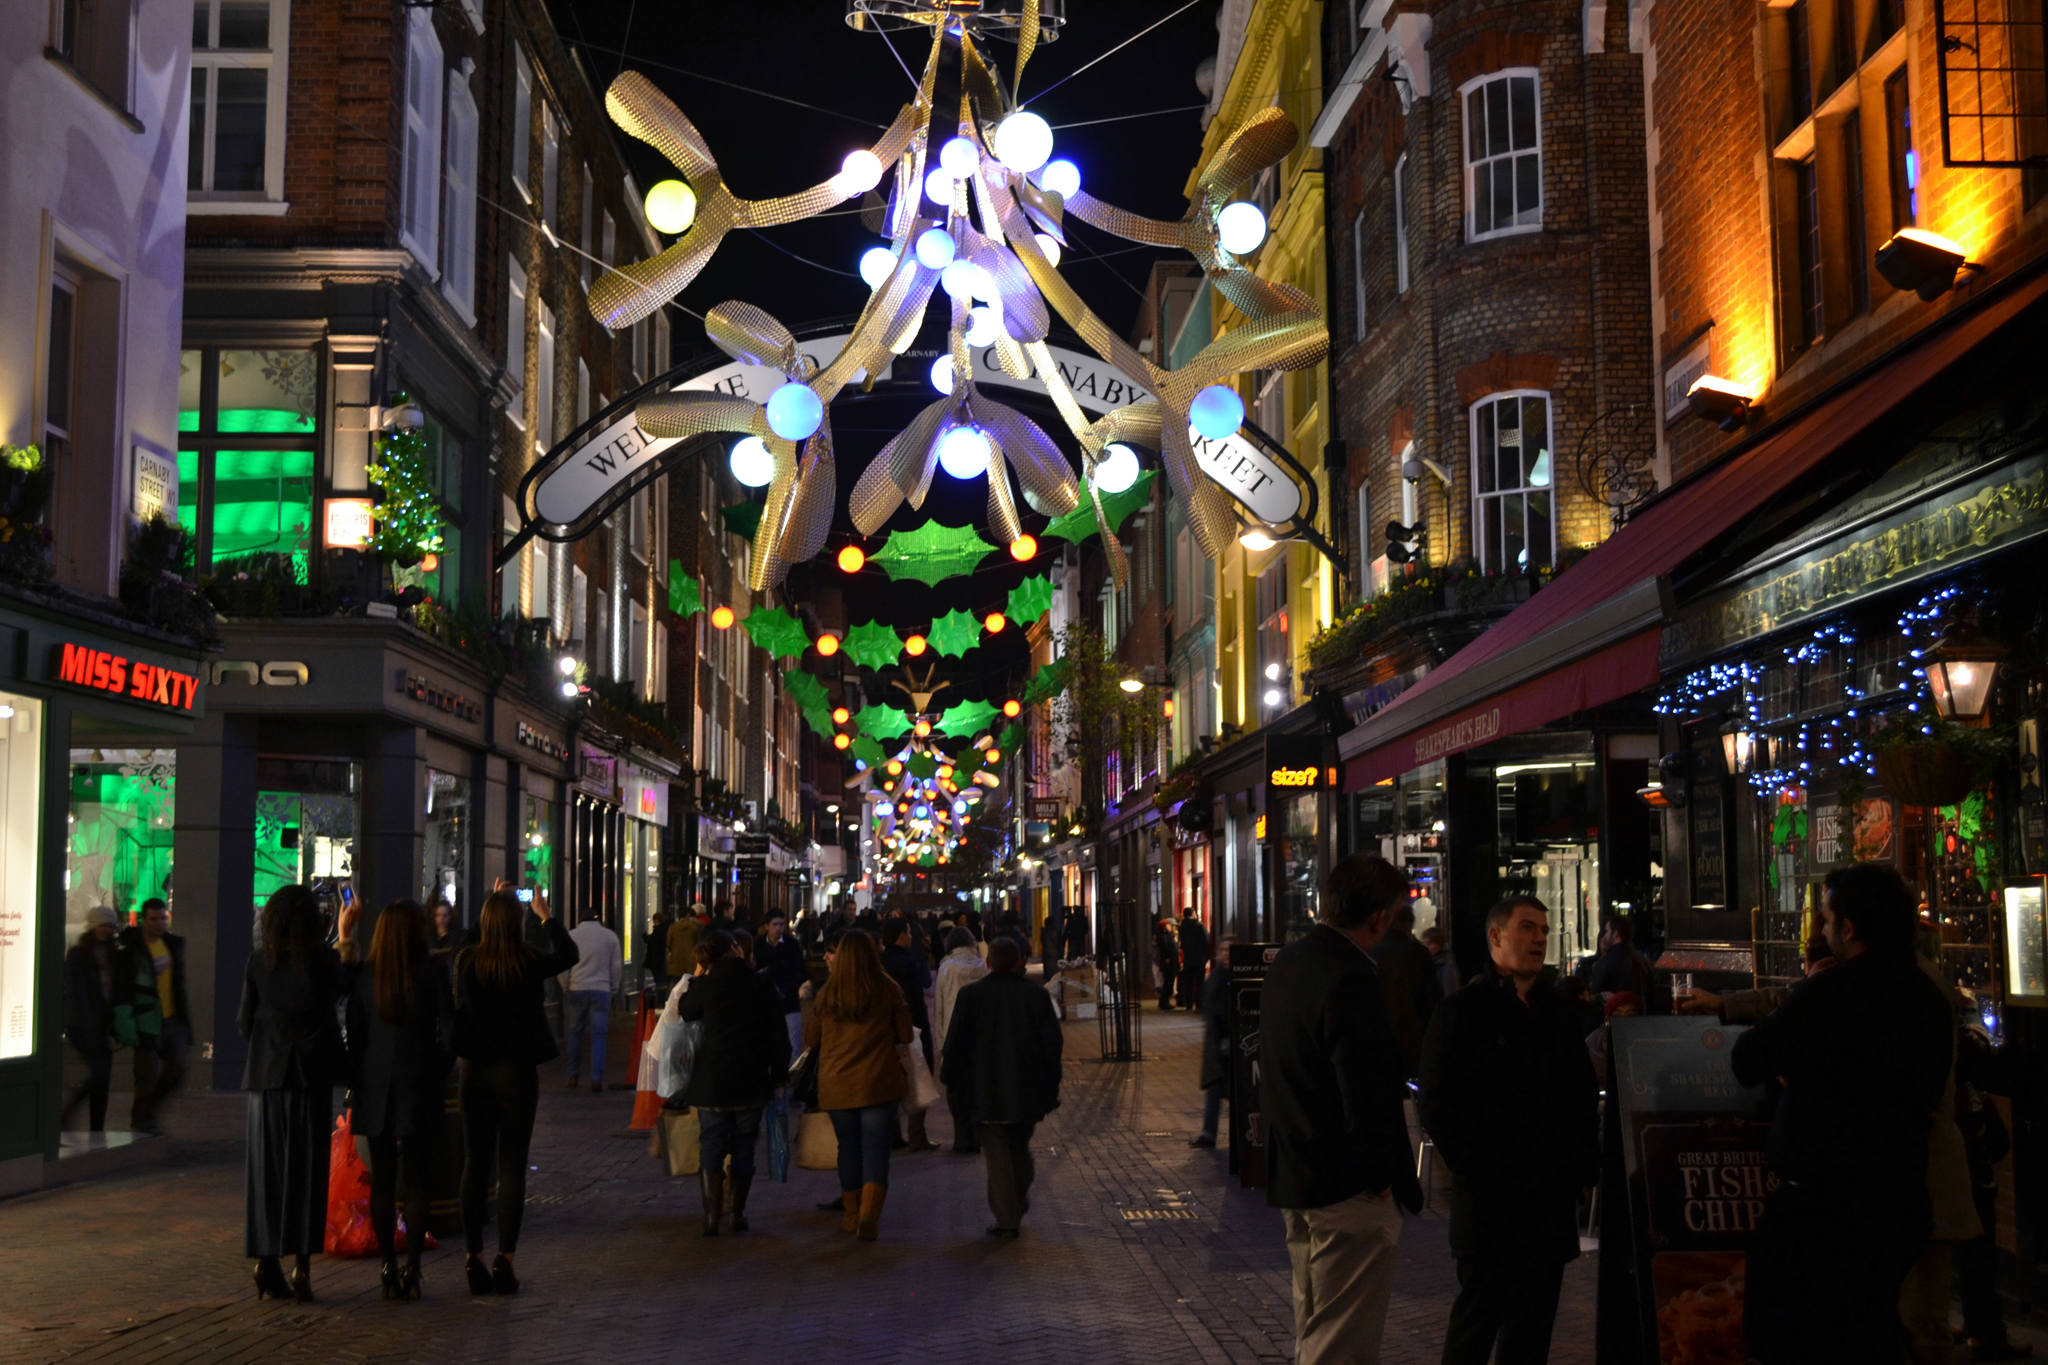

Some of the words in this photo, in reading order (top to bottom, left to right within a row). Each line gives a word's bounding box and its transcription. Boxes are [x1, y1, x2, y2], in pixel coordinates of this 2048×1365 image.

[900, 350, 939, 358] CARNABY
[585, 374, 749, 476] WELE
[982, 346, 1147, 405] CNABY
[1192, 435, 1273, 495] REET
[141, 455, 170, 484] CARNABY
[140, 476, 164, 500] STREET
[167, 487, 176, 506] W1
[60, 643, 128, 693] MISS
[131, 661, 199, 710] SIXTY
[1415, 716, 1473, 763] SHAKESPEARE'S
[1474, 708, 1500, 742] HEAD
[1271, 766, 1319, 786] size?
[1035, 803, 1056, 814] MUJI
[1816, 815, 1838, 841] FISH
[1697, 855, 1722, 877] FOOD
[1671, 1072, 1734, 1085] SHAKESPE
[1704, 1086, 1737, 1098] HEAD
[1677, 1151, 1719, 1166] GREAT
[1722, 1150, 1768, 1165] BRITIS
[1679, 1166, 1766, 1199] FISH
[1766, 1171, 1781, 1192] &
[1684, 1199, 1765, 1232] CHIP
